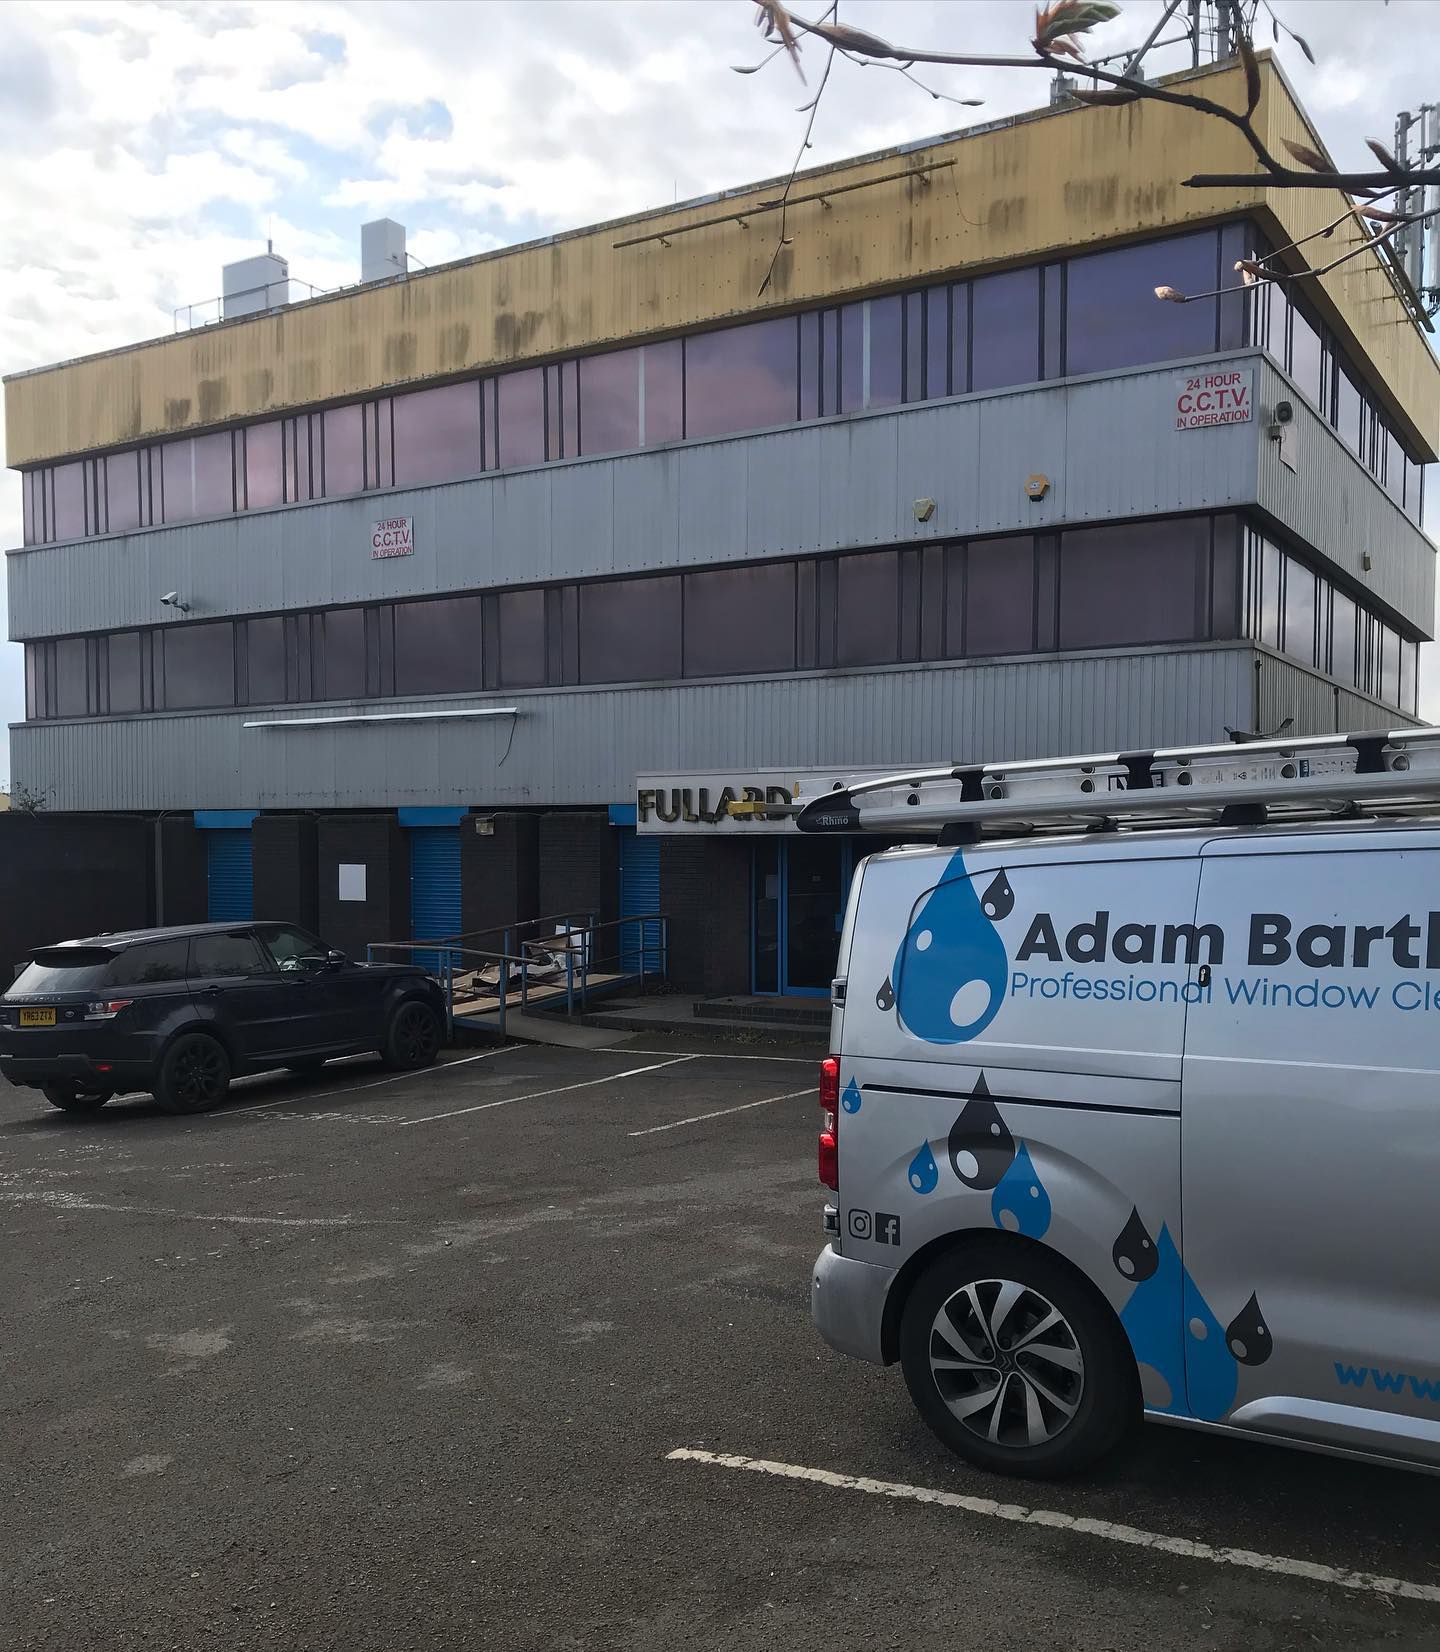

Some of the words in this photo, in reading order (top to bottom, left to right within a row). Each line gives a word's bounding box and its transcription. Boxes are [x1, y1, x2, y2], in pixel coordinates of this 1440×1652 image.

[1186, 379, 1200, 391] 24
[1205, 373, 1241, 388] HOUR
[1177, 387, 1249, 413] C.C.T.V.
[1176, 416, 1187, 428] IN
[1190, 409, 1249, 426] OPERATION
[377, 522, 385, 531] 24
[386, 519, 407, 530] HOUR
[372, 529, 411, 548] C.C.T.V.
[372, 550, 379, 558] IN
[380, 546, 412, 557] OPERATION
[822, 815, 849, 826] Rhino
[1014, 910, 1225, 965] Adam
[1010, 972, 1212, 1004] Professional
[1224, 977, 1381, 1009] Window
